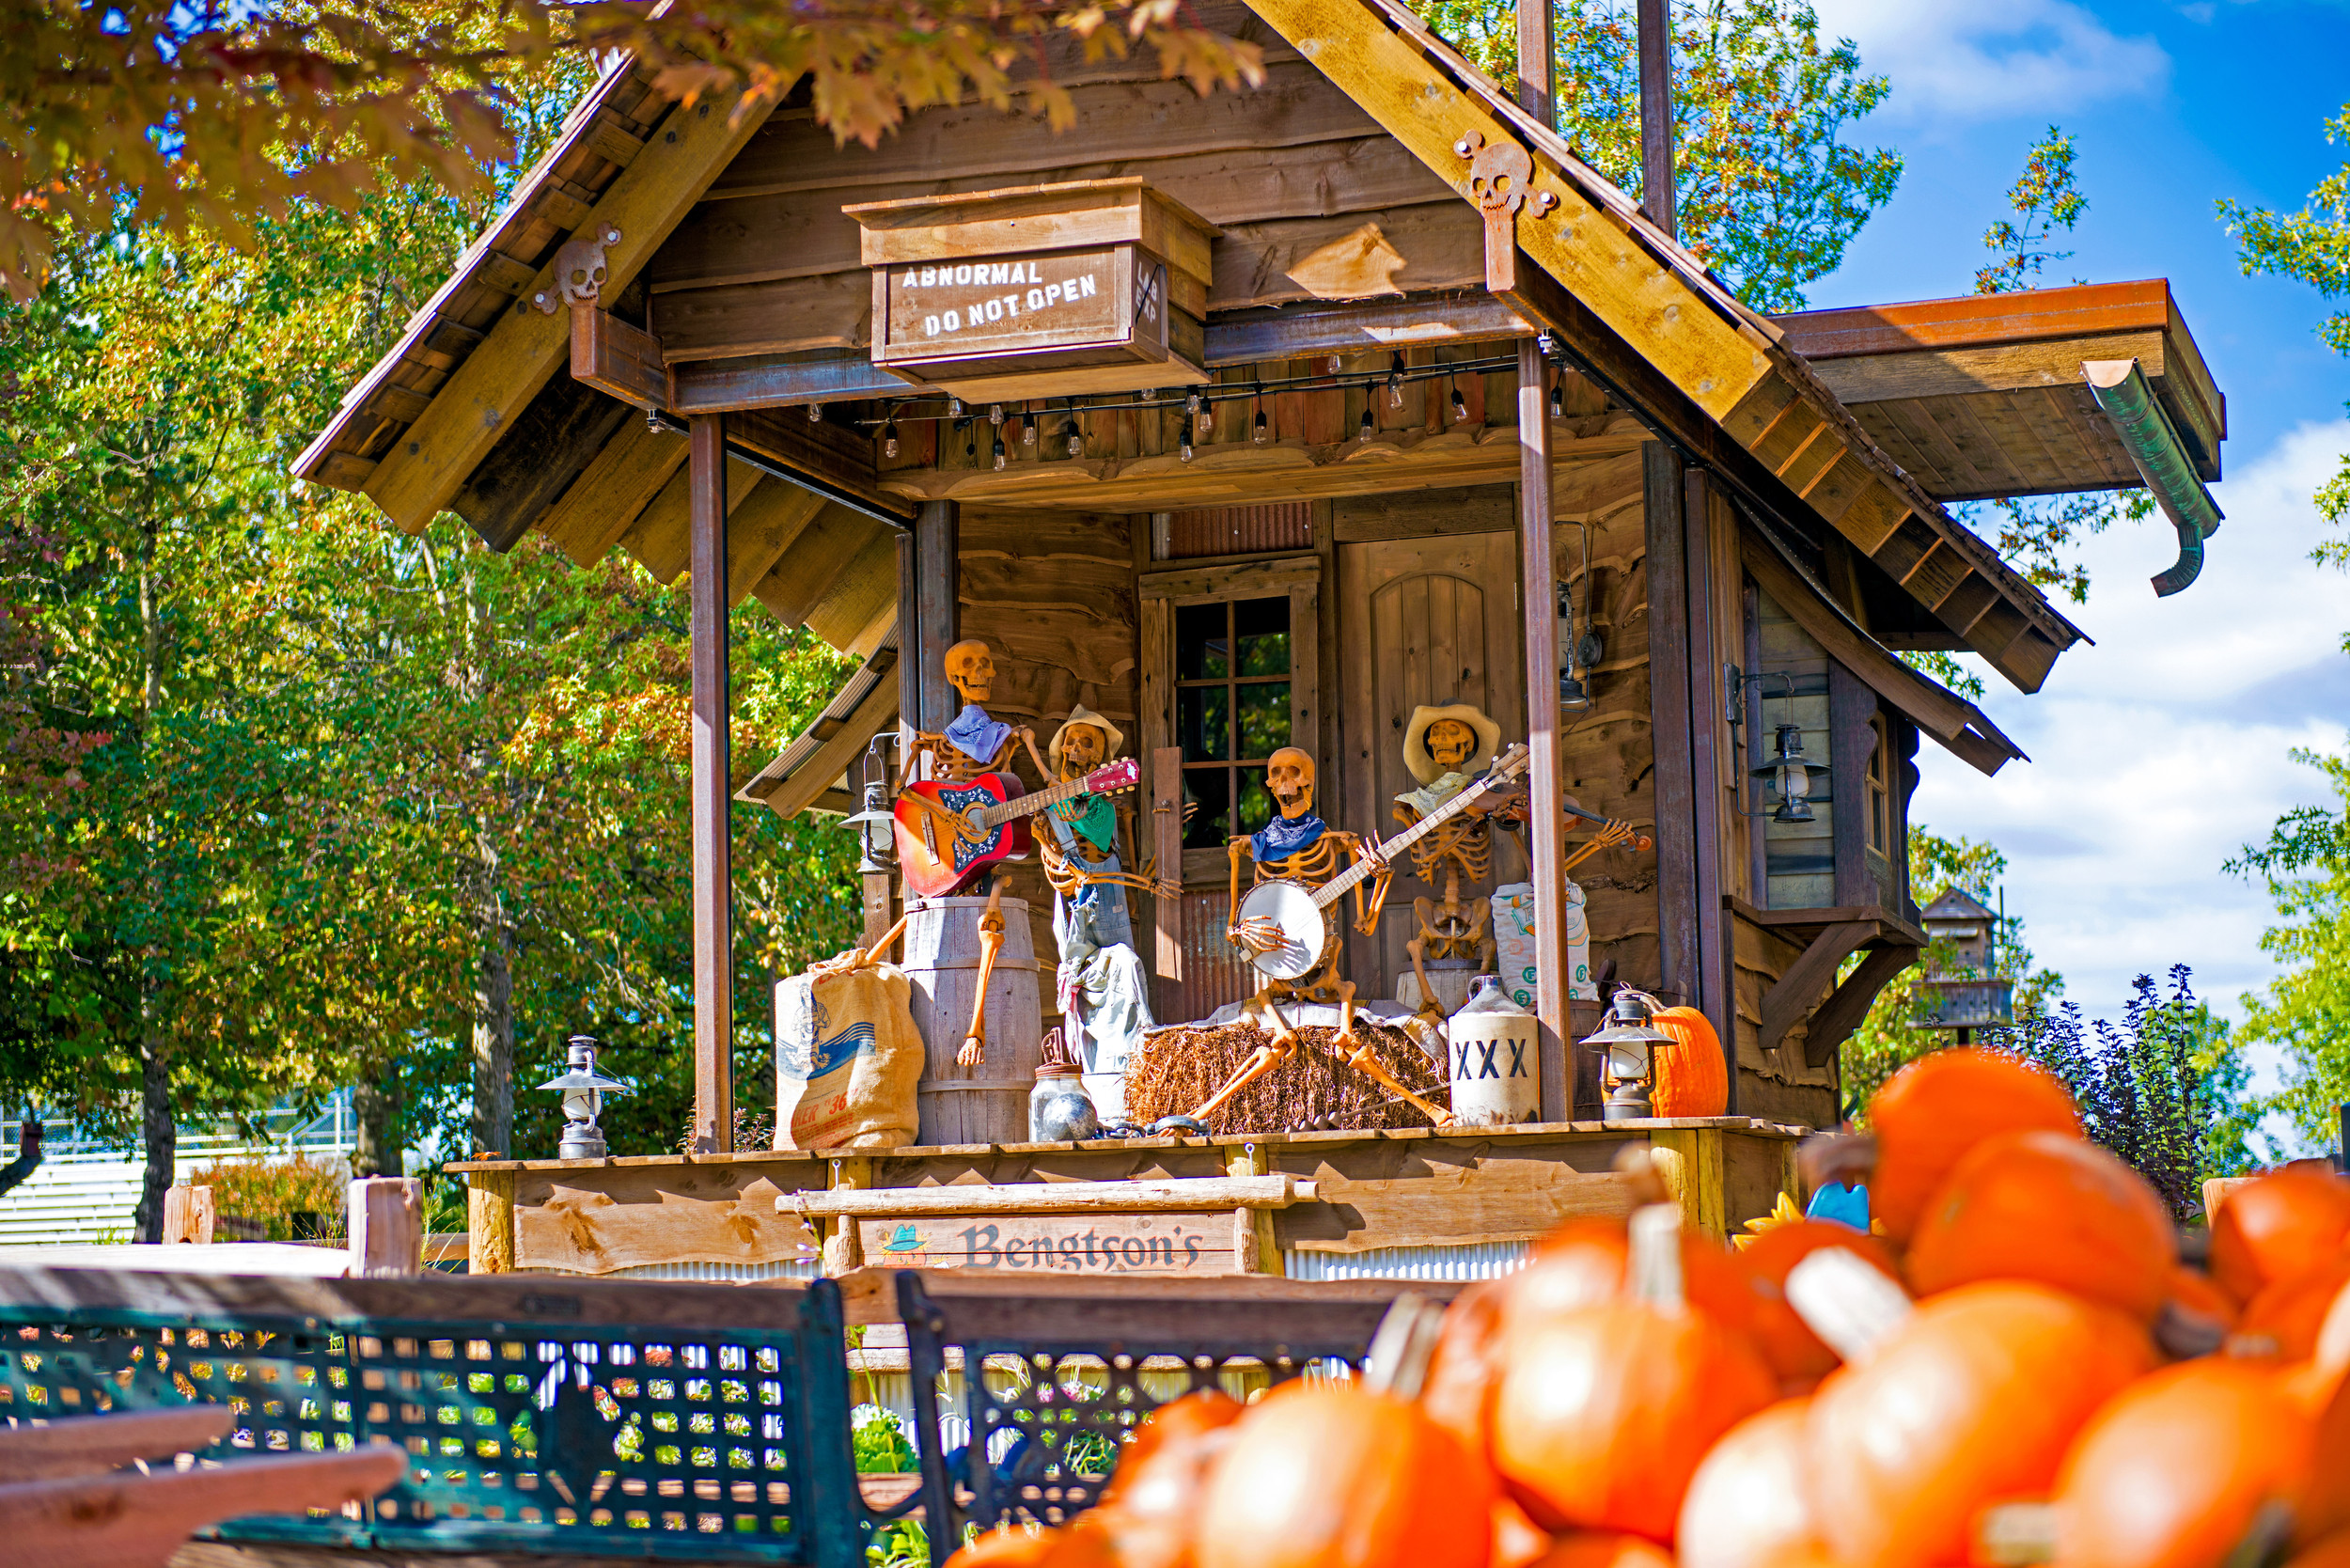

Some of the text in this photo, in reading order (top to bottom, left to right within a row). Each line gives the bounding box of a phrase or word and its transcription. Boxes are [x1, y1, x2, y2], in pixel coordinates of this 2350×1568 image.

[902, 262, 1042, 288] ABNORMAL
[1137, 261, 1157, 301] LAB
[925, 274, 1096, 337] DO NOT OPEN
[1136, 285, 1156, 323] EXP
[1455, 1039, 1528, 1080] XXX
[957, 1224, 1203, 1272] Bengtson's
